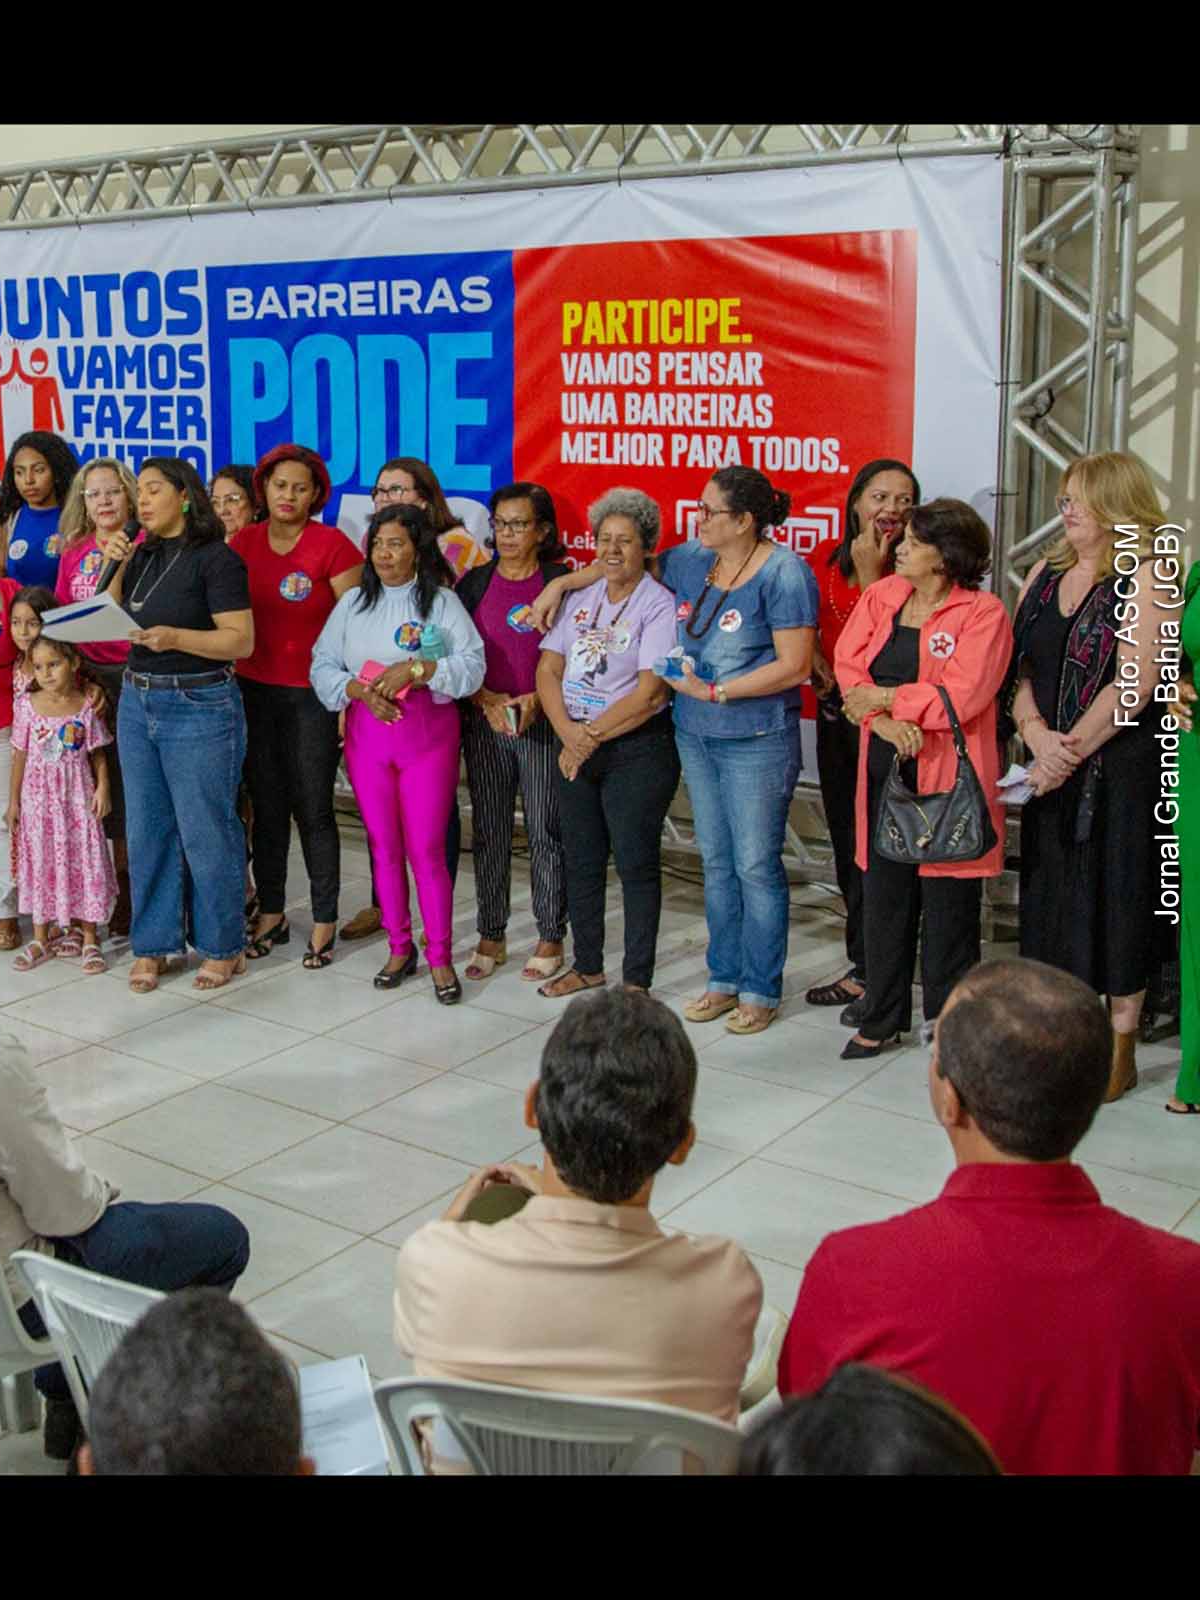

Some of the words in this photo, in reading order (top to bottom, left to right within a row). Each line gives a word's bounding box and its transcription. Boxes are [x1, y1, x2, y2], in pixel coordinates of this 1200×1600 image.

[225, 275, 494, 321] BARREIRAS
[562, 298, 753, 346] PARTICIPE.
[57, 343, 206, 391] VAMOS
[560, 351, 651, 387] VAMOS
[658, 351, 765, 387] PENSAR
[72, 394, 208, 441] FAZER
[228, 331, 494, 492] PODE
[560, 391, 619, 426] UMA
[624, 391, 774, 429] BARREIRAS
[560, 431, 665, 467] MELHOR
[670, 433, 743, 469] PARA
[748, 436, 850, 474] TODOS.
